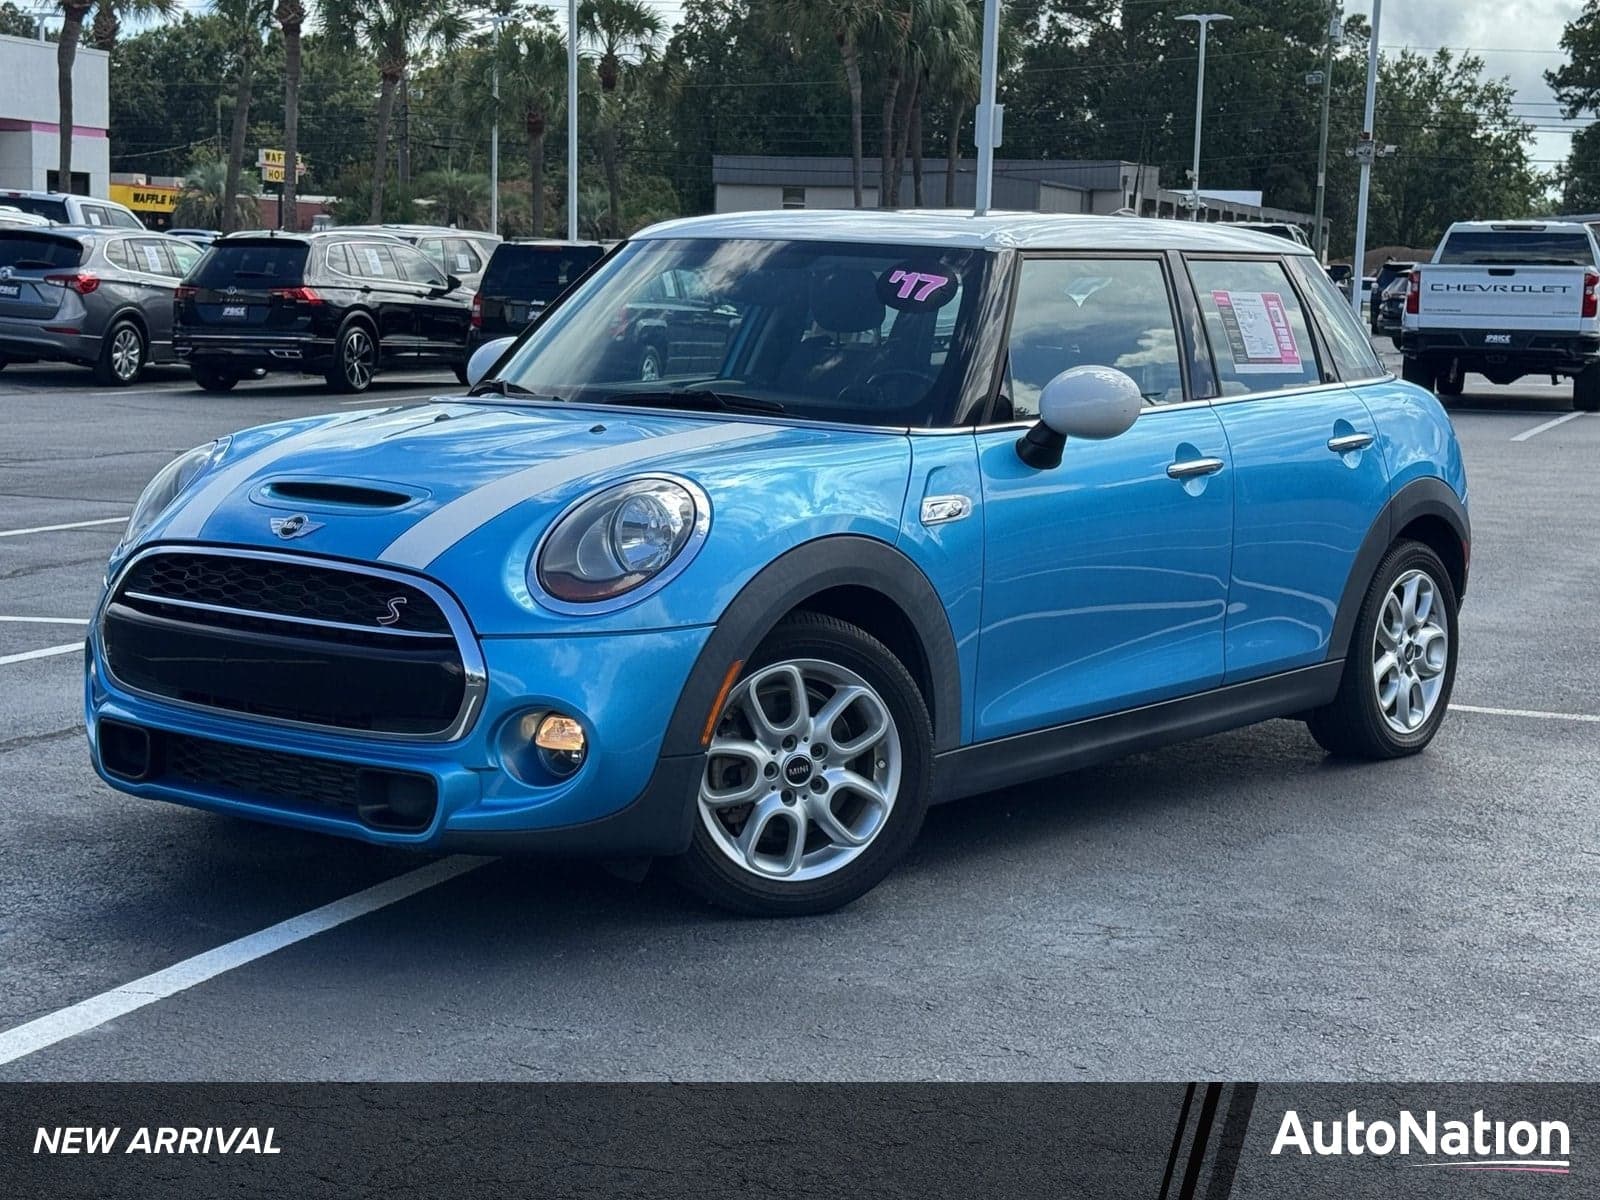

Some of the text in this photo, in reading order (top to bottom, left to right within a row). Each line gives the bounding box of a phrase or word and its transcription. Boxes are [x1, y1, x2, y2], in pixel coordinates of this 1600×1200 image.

[132, 192, 167, 205] WAFFLE
[1430, 282, 1572, 294] CHEVROLET
[376, 597, 408, 626] S
[788, 764, 809, 776] MINI
